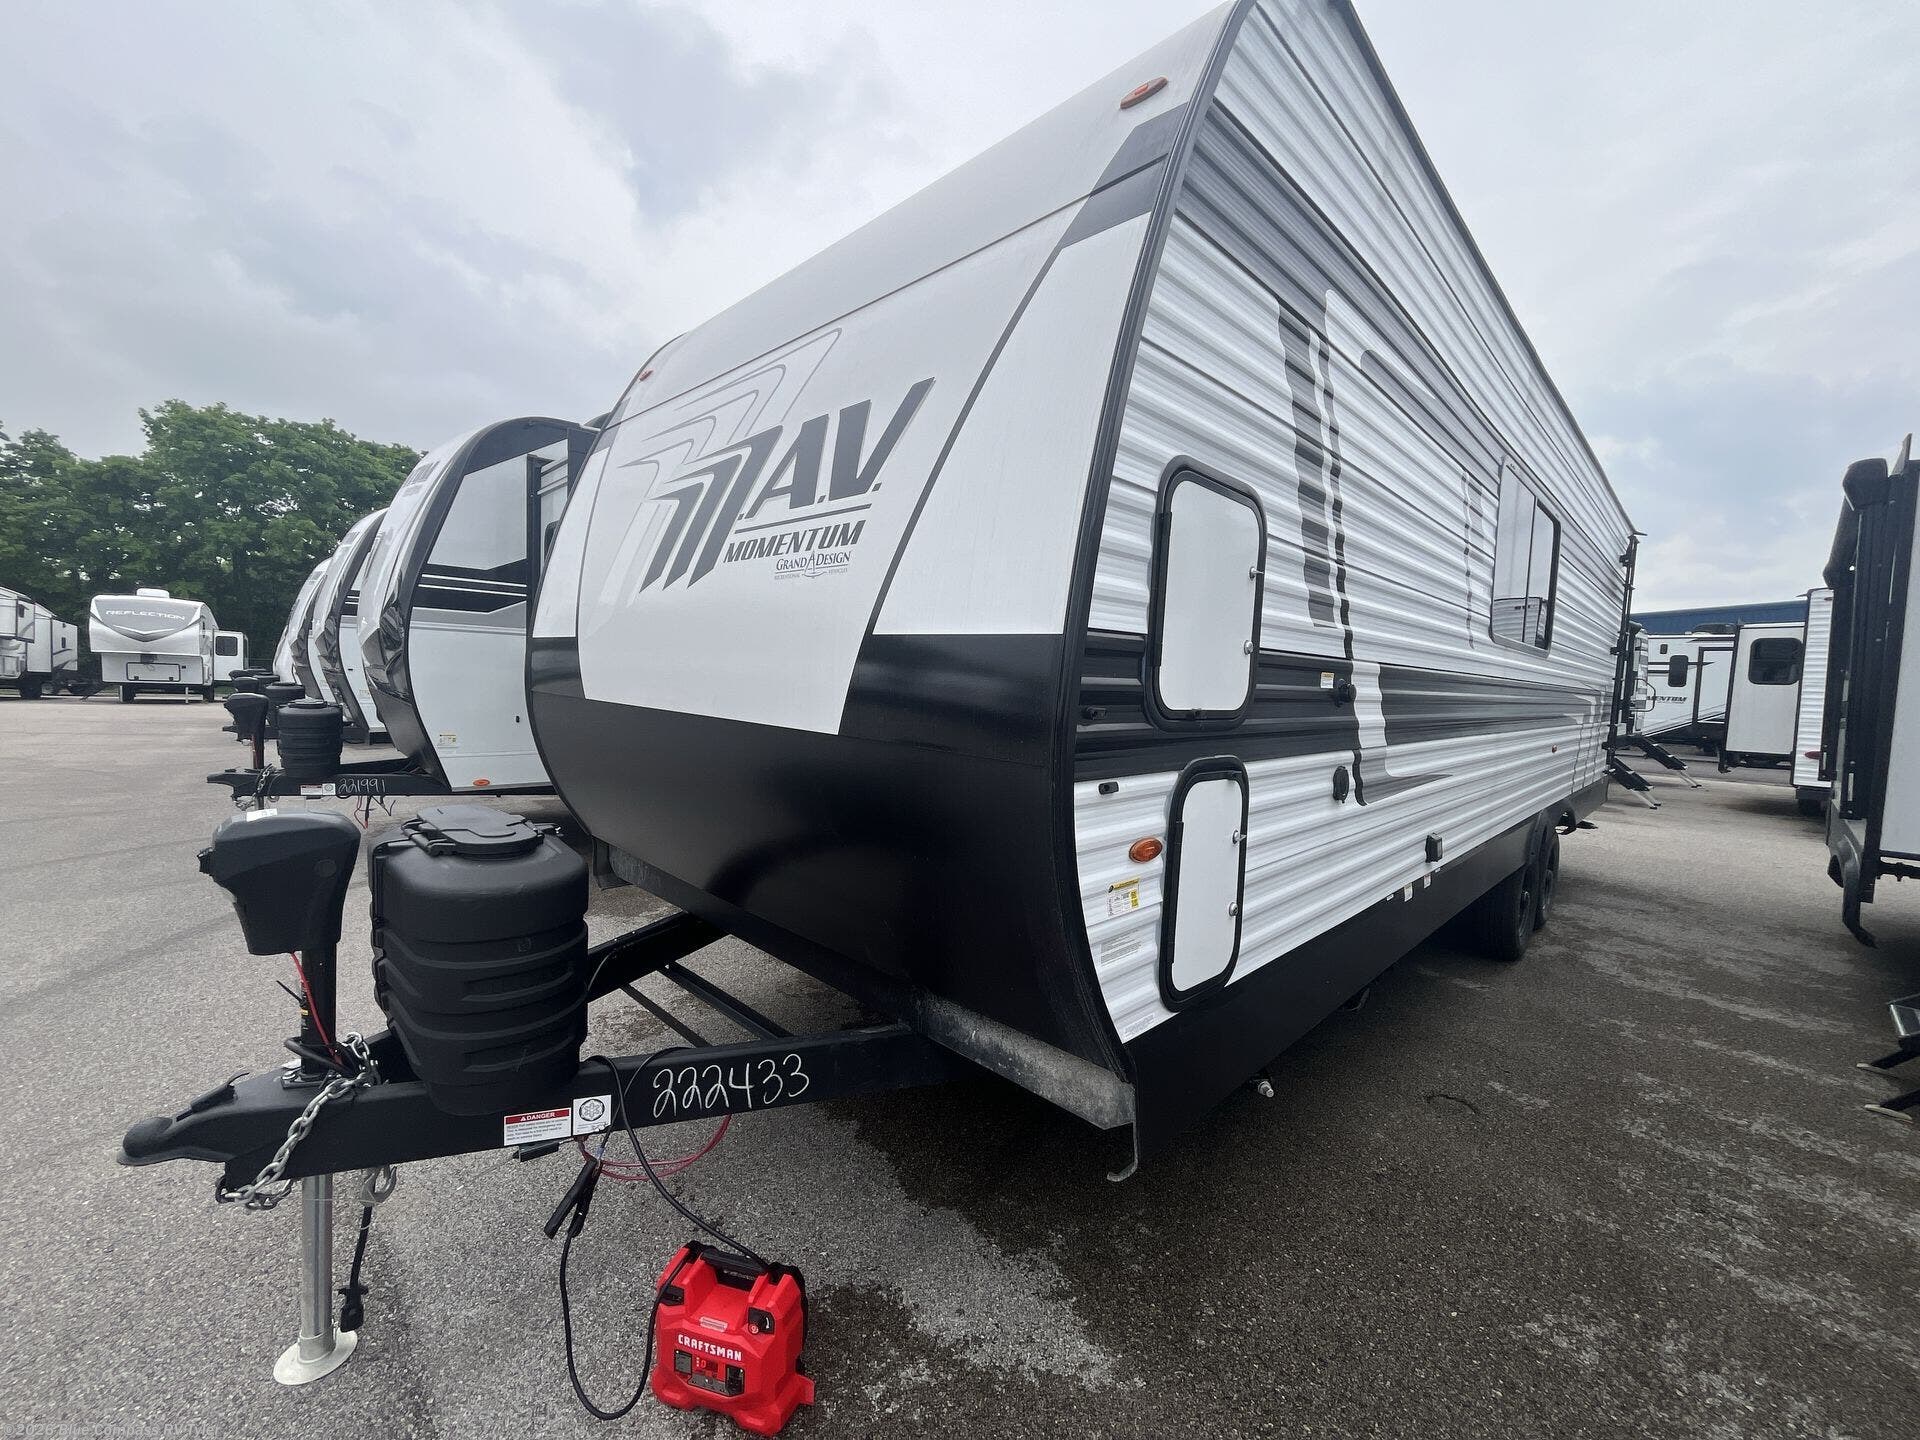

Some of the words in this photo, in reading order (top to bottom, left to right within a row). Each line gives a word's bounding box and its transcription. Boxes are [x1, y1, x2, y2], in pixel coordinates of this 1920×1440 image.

[723, 520, 866, 563] MOMENTUM
[776, 557, 807, 571] GRAND
[816, 551, 851, 566] DESIGN
[106, 610, 186, 620] REFLECTION
[338, 778, 386, 793] 221991
[653, 1053, 810, 1119] 222433
[526, 1112, 556, 1121] DANGER
[678, 1334, 742, 1361] CRAFTSMAN
